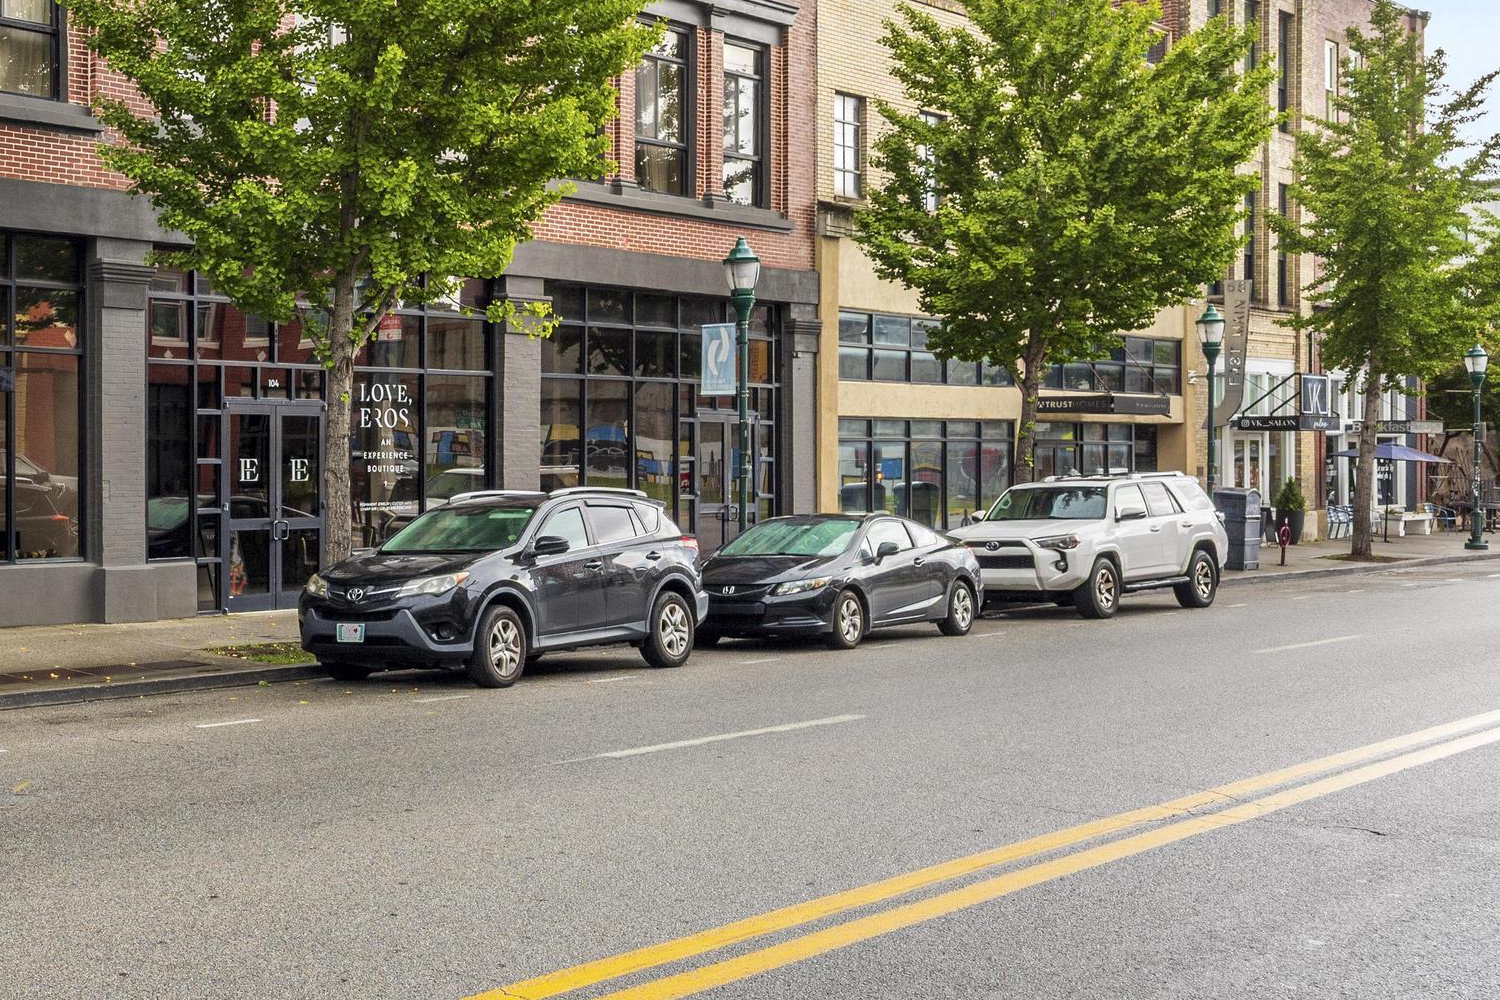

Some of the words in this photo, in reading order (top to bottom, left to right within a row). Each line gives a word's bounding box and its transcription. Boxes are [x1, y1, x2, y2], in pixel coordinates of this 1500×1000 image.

[268, 379, 279, 388] 104
[360, 407, 409, 428] EROS
[1352, 421, 1412, 433] Bkfast
[380, 438, 392, 446] AN
[363, 451, 408, 460] EXPERIENCE
[367, 464, 404, 473] BOUTIQUE
